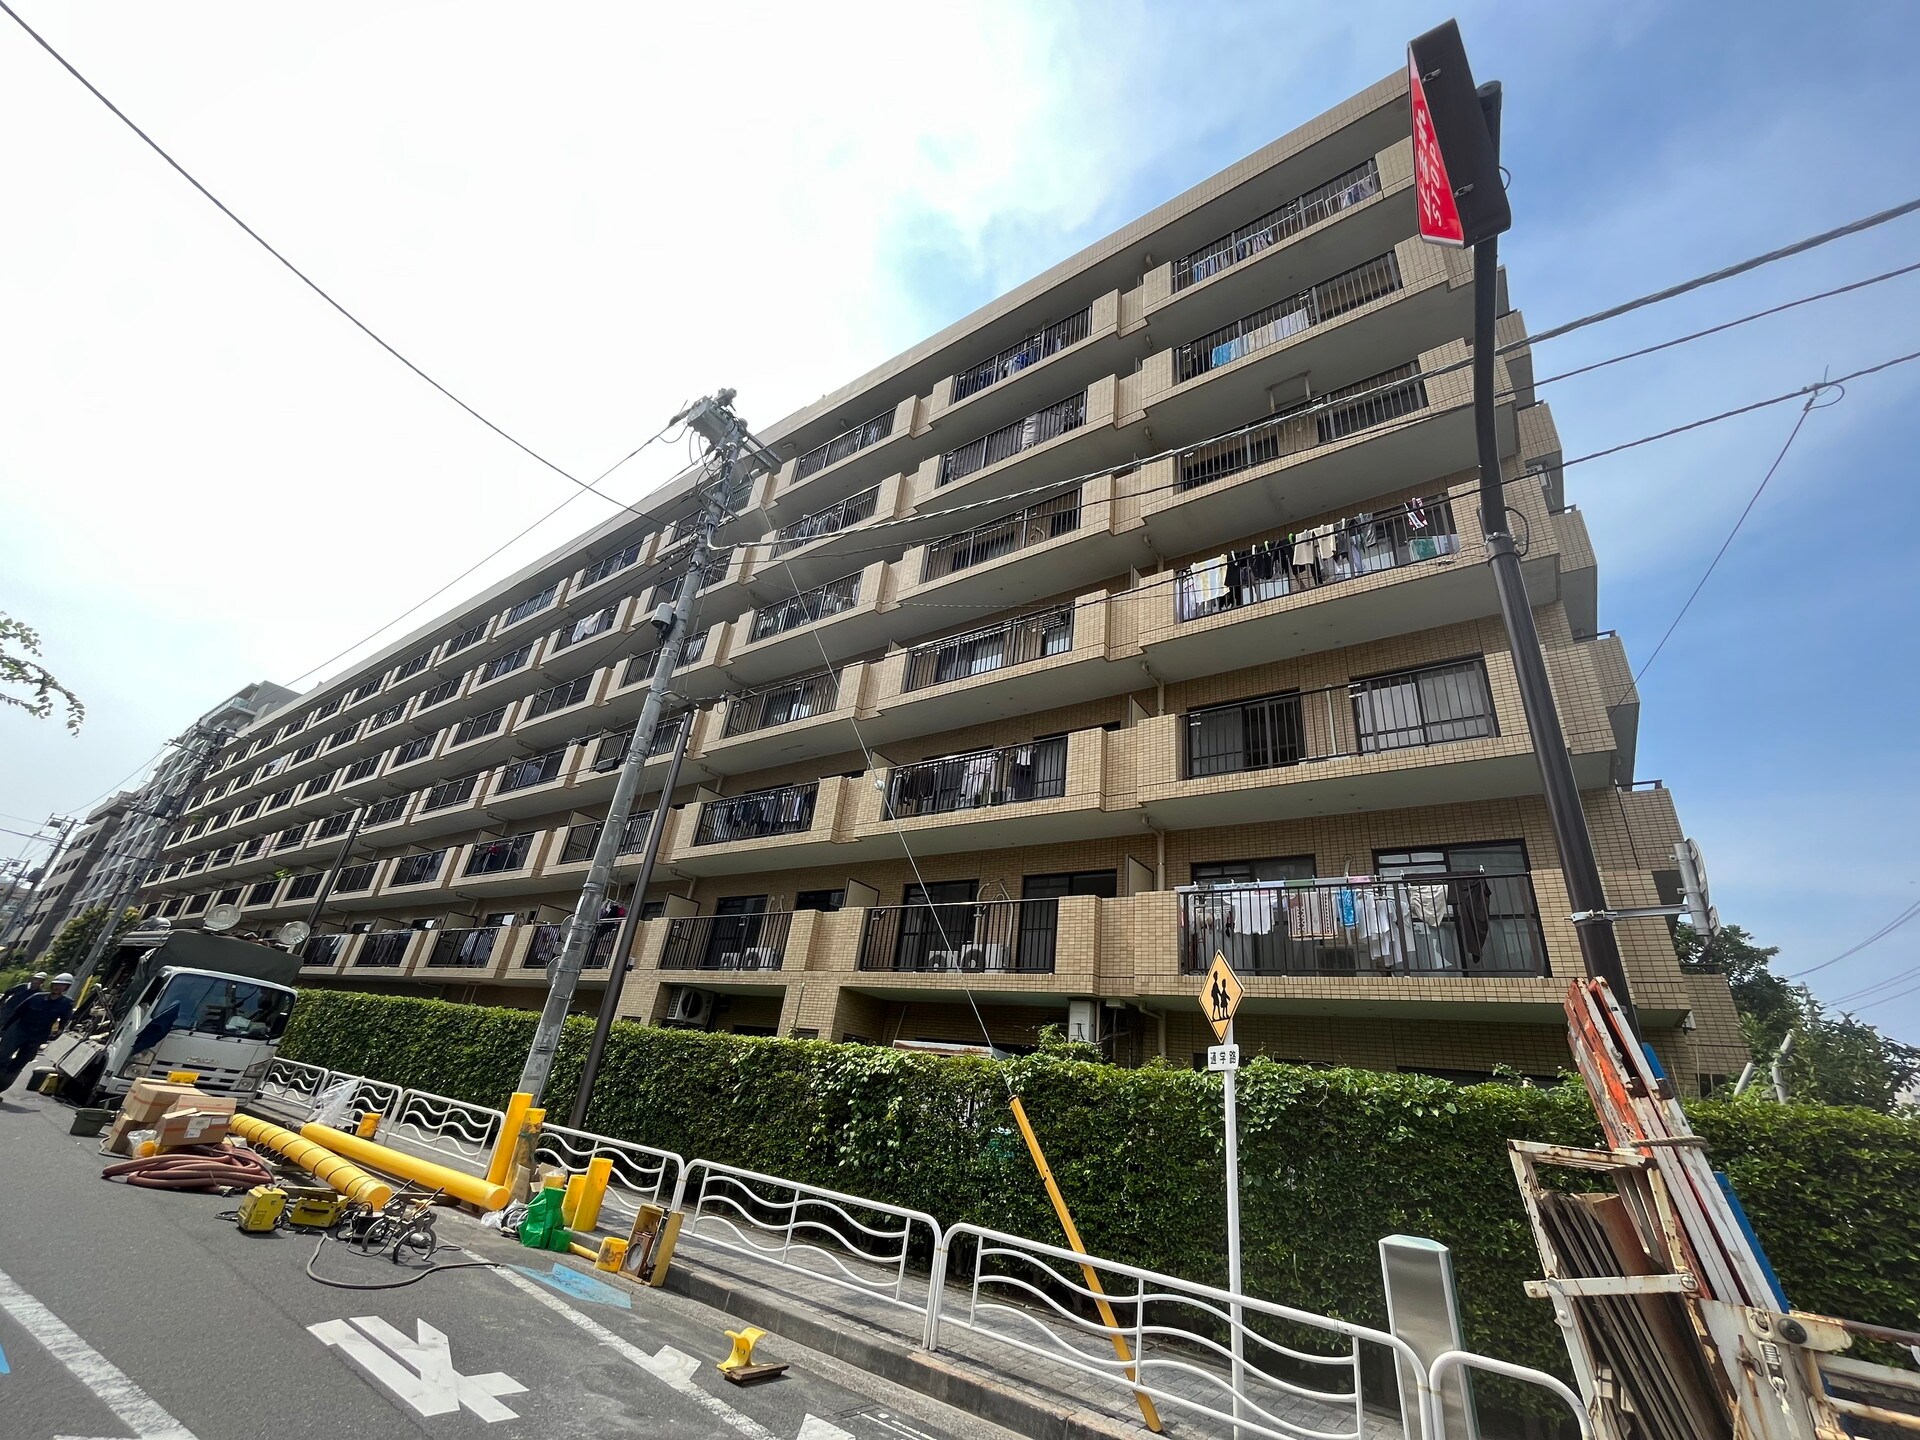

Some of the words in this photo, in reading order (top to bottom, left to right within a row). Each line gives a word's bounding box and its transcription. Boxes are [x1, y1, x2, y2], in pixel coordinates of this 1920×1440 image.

[1416, 108, 1432, 225] 止まれ
[1430, 142, 1442, 227] STOP
[1210, 1050, 1237, 1065] 通学路
